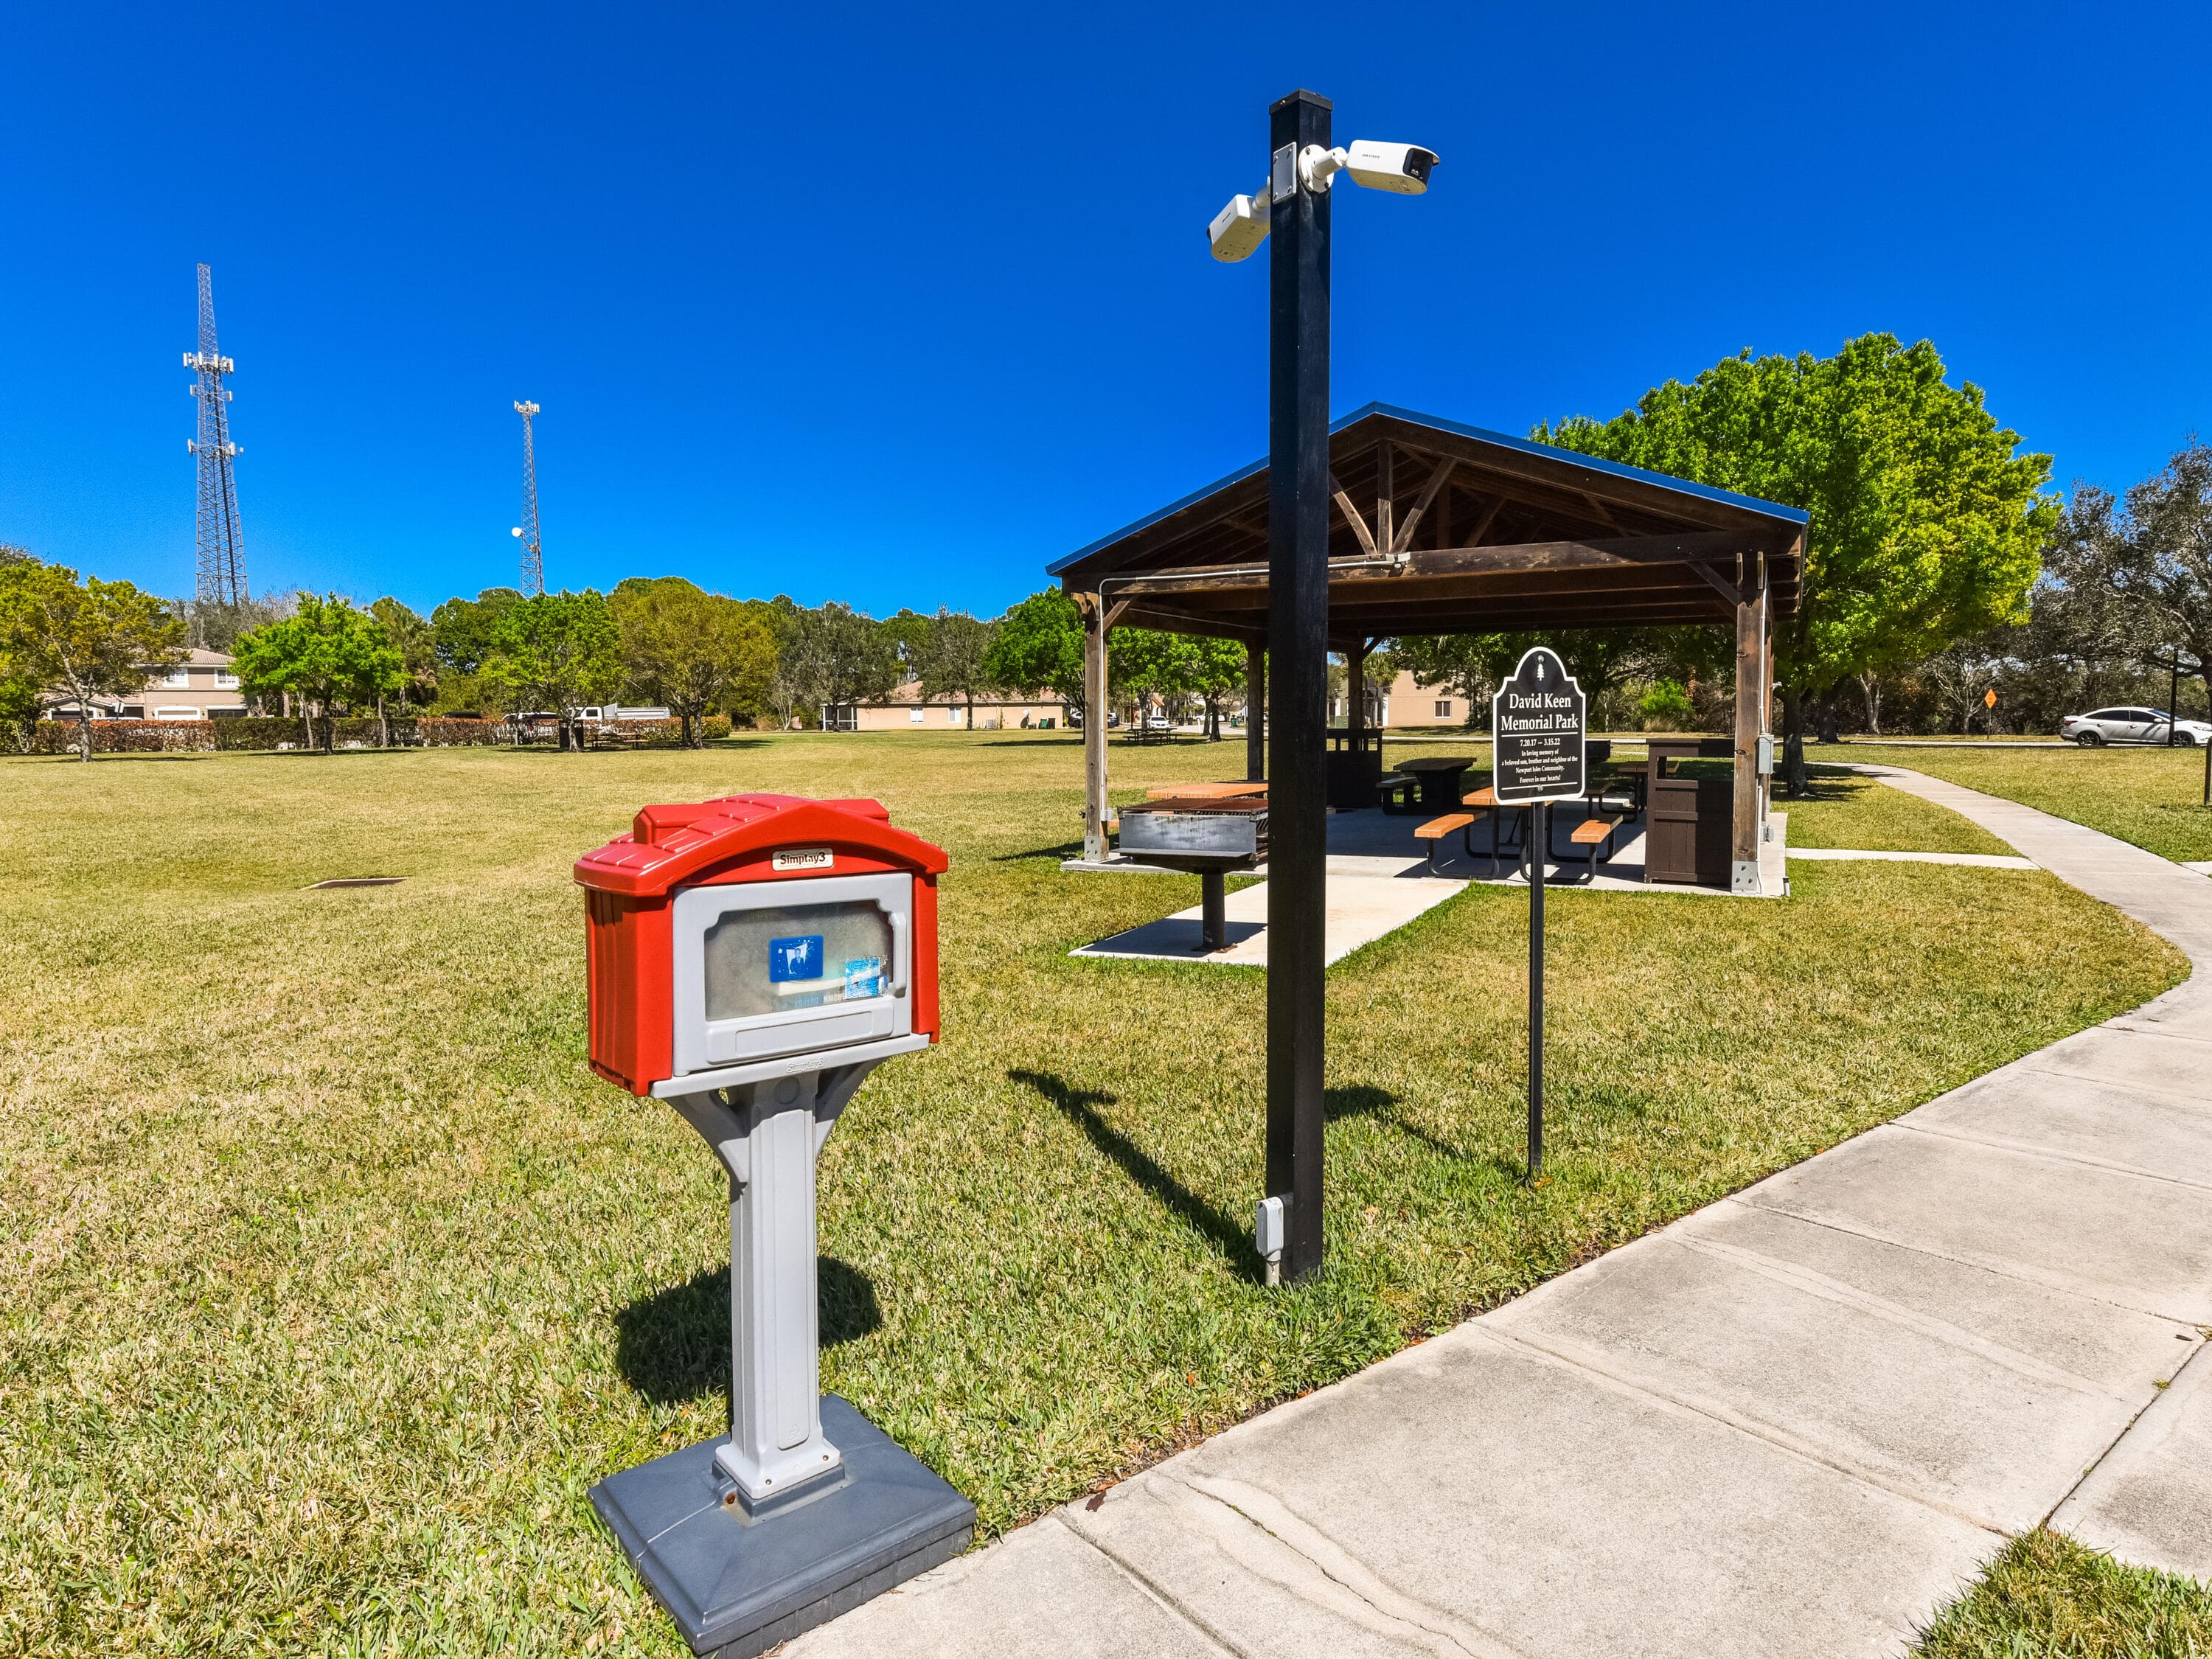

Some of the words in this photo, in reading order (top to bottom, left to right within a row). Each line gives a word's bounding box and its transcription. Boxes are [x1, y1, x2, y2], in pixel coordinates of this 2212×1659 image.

[1509, 692, 1542, 709] David
[1544, 692, 1571, 708] Keen
[1500, 714, 1553, 731] Memorial
[1555, 713, 1579, 729] Park
[1520, 739, 1537, 747] 7.20.17
[1527, 749, 1539, 757] loving
[1551, 756, 1567, 765] neighbor
[780, 852, 826, 865] Simplay3
